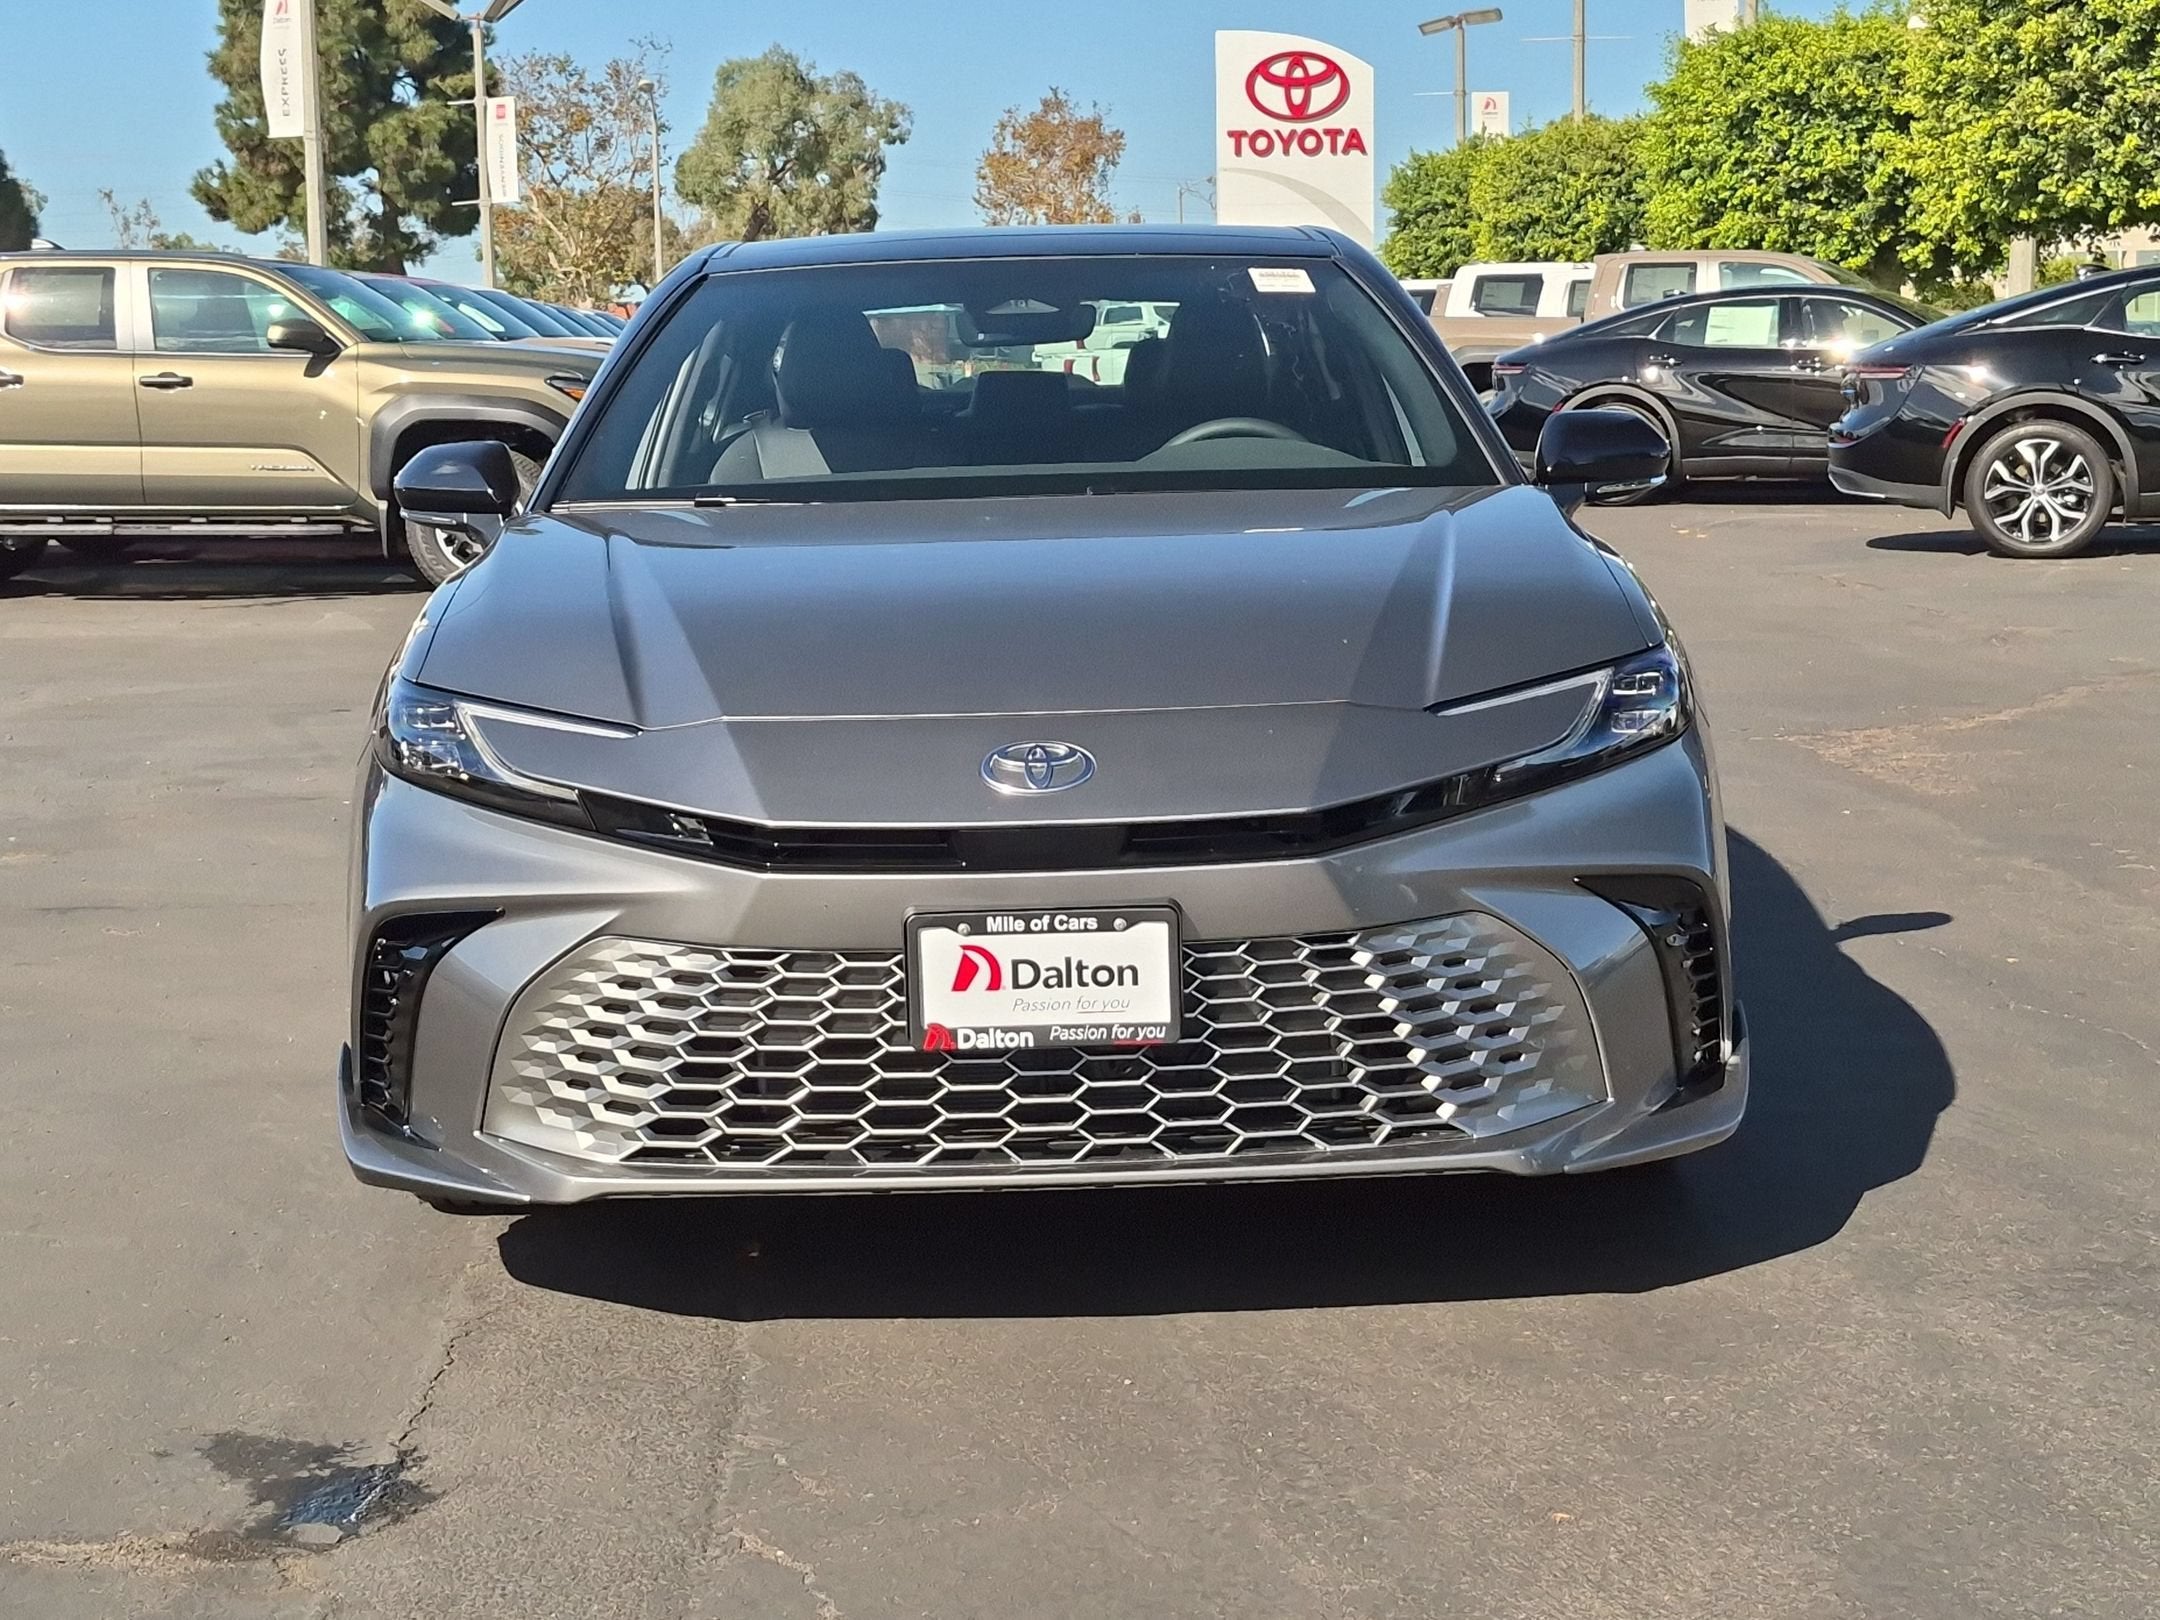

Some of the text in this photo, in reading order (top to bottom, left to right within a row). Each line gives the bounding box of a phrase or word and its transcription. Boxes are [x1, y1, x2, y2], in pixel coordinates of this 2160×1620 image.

[1227, 128, 1368, 157] TOYOTA
[986, 915, 1098, 933] Mile of Cars
[1011, 956, 1139, 990] Dalton
[1012, 996, 1130, 1012] Passion for you
[957, 1028, 1034, 1050] Dalton
[1049, 1023, 1166, 1041] Passion for you
